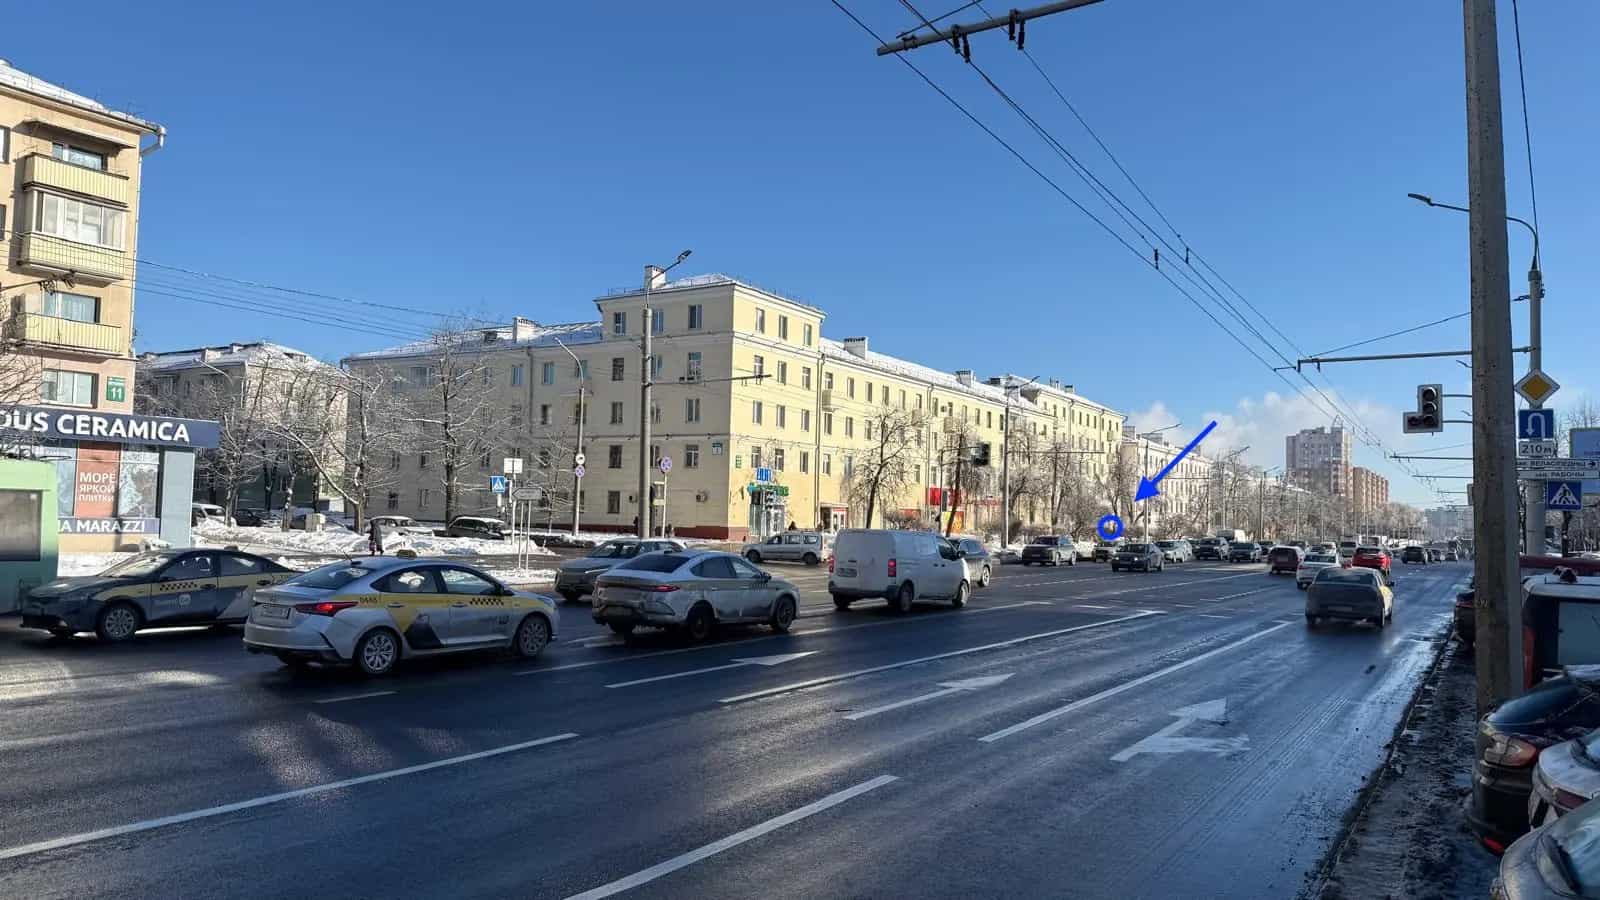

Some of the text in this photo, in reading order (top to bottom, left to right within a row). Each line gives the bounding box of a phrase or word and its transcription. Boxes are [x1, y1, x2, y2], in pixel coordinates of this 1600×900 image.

[111, 387, 122, 400] 11
[57, 413, 190, 442] CERAMICA
[1521, 444, 1542, 454] 210
[79, 471, 117, 483] МОРЕ
[79, 482, 116, 493] ЯРКОЙ
[78, 493, 114, 502] ПЛИТКИ
[76, 519, 145, 533] MARAZZI
